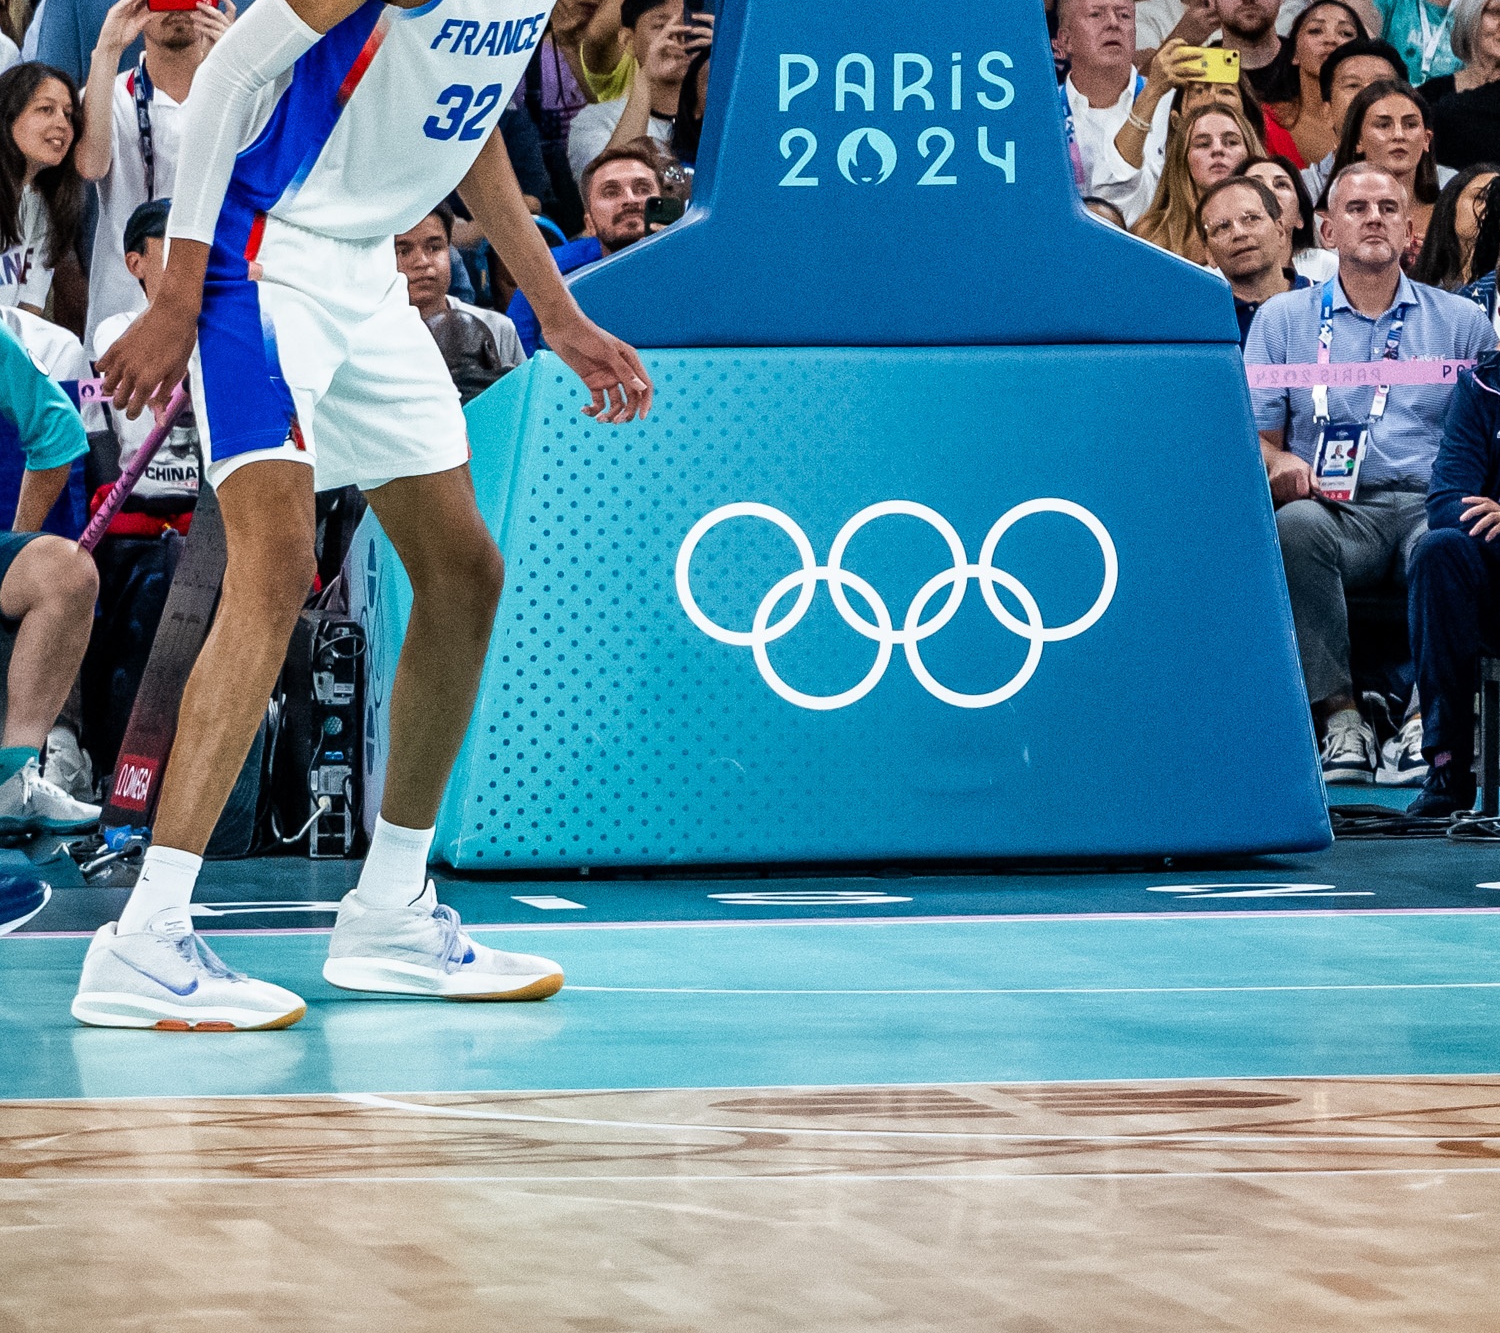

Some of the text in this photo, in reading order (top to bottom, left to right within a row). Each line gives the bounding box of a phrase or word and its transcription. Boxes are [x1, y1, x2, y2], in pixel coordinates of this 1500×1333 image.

[430, 17, 544, 56] FRANCE
[423, 84, 502, 141] 32
[147, 466, 198, 482] CHINA
